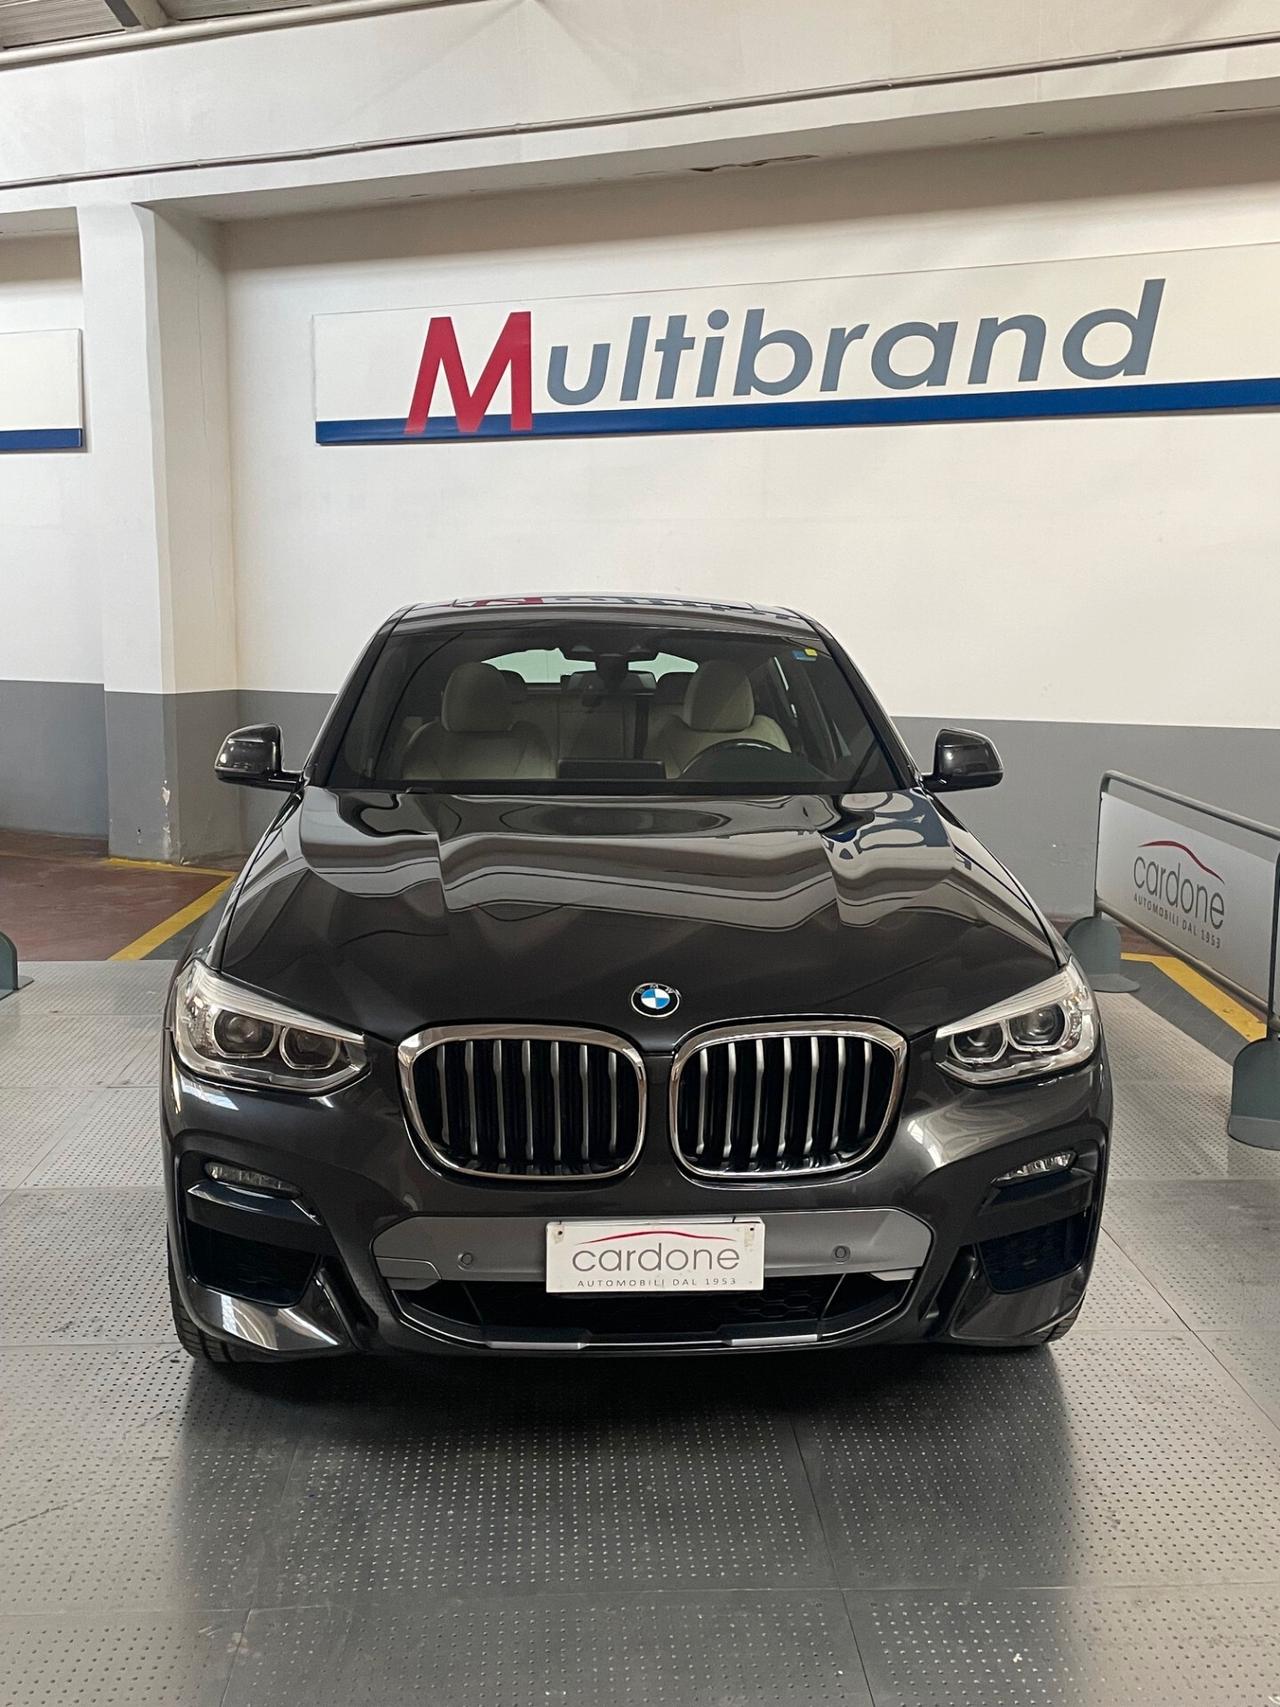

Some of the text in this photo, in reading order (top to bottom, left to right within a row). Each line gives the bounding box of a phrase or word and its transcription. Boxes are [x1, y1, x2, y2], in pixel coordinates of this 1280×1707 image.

[403, 278, 1166, 435] Multibrand
[1133, 856, 1225, 930] cardone
[1134, 893, 1221, 949] AUTOMOBILI DAL 1953
[572, 1242, 740, 1272] cardone
[577, 1277, 737, 1288] AUTOMOBILI DAL 1953
